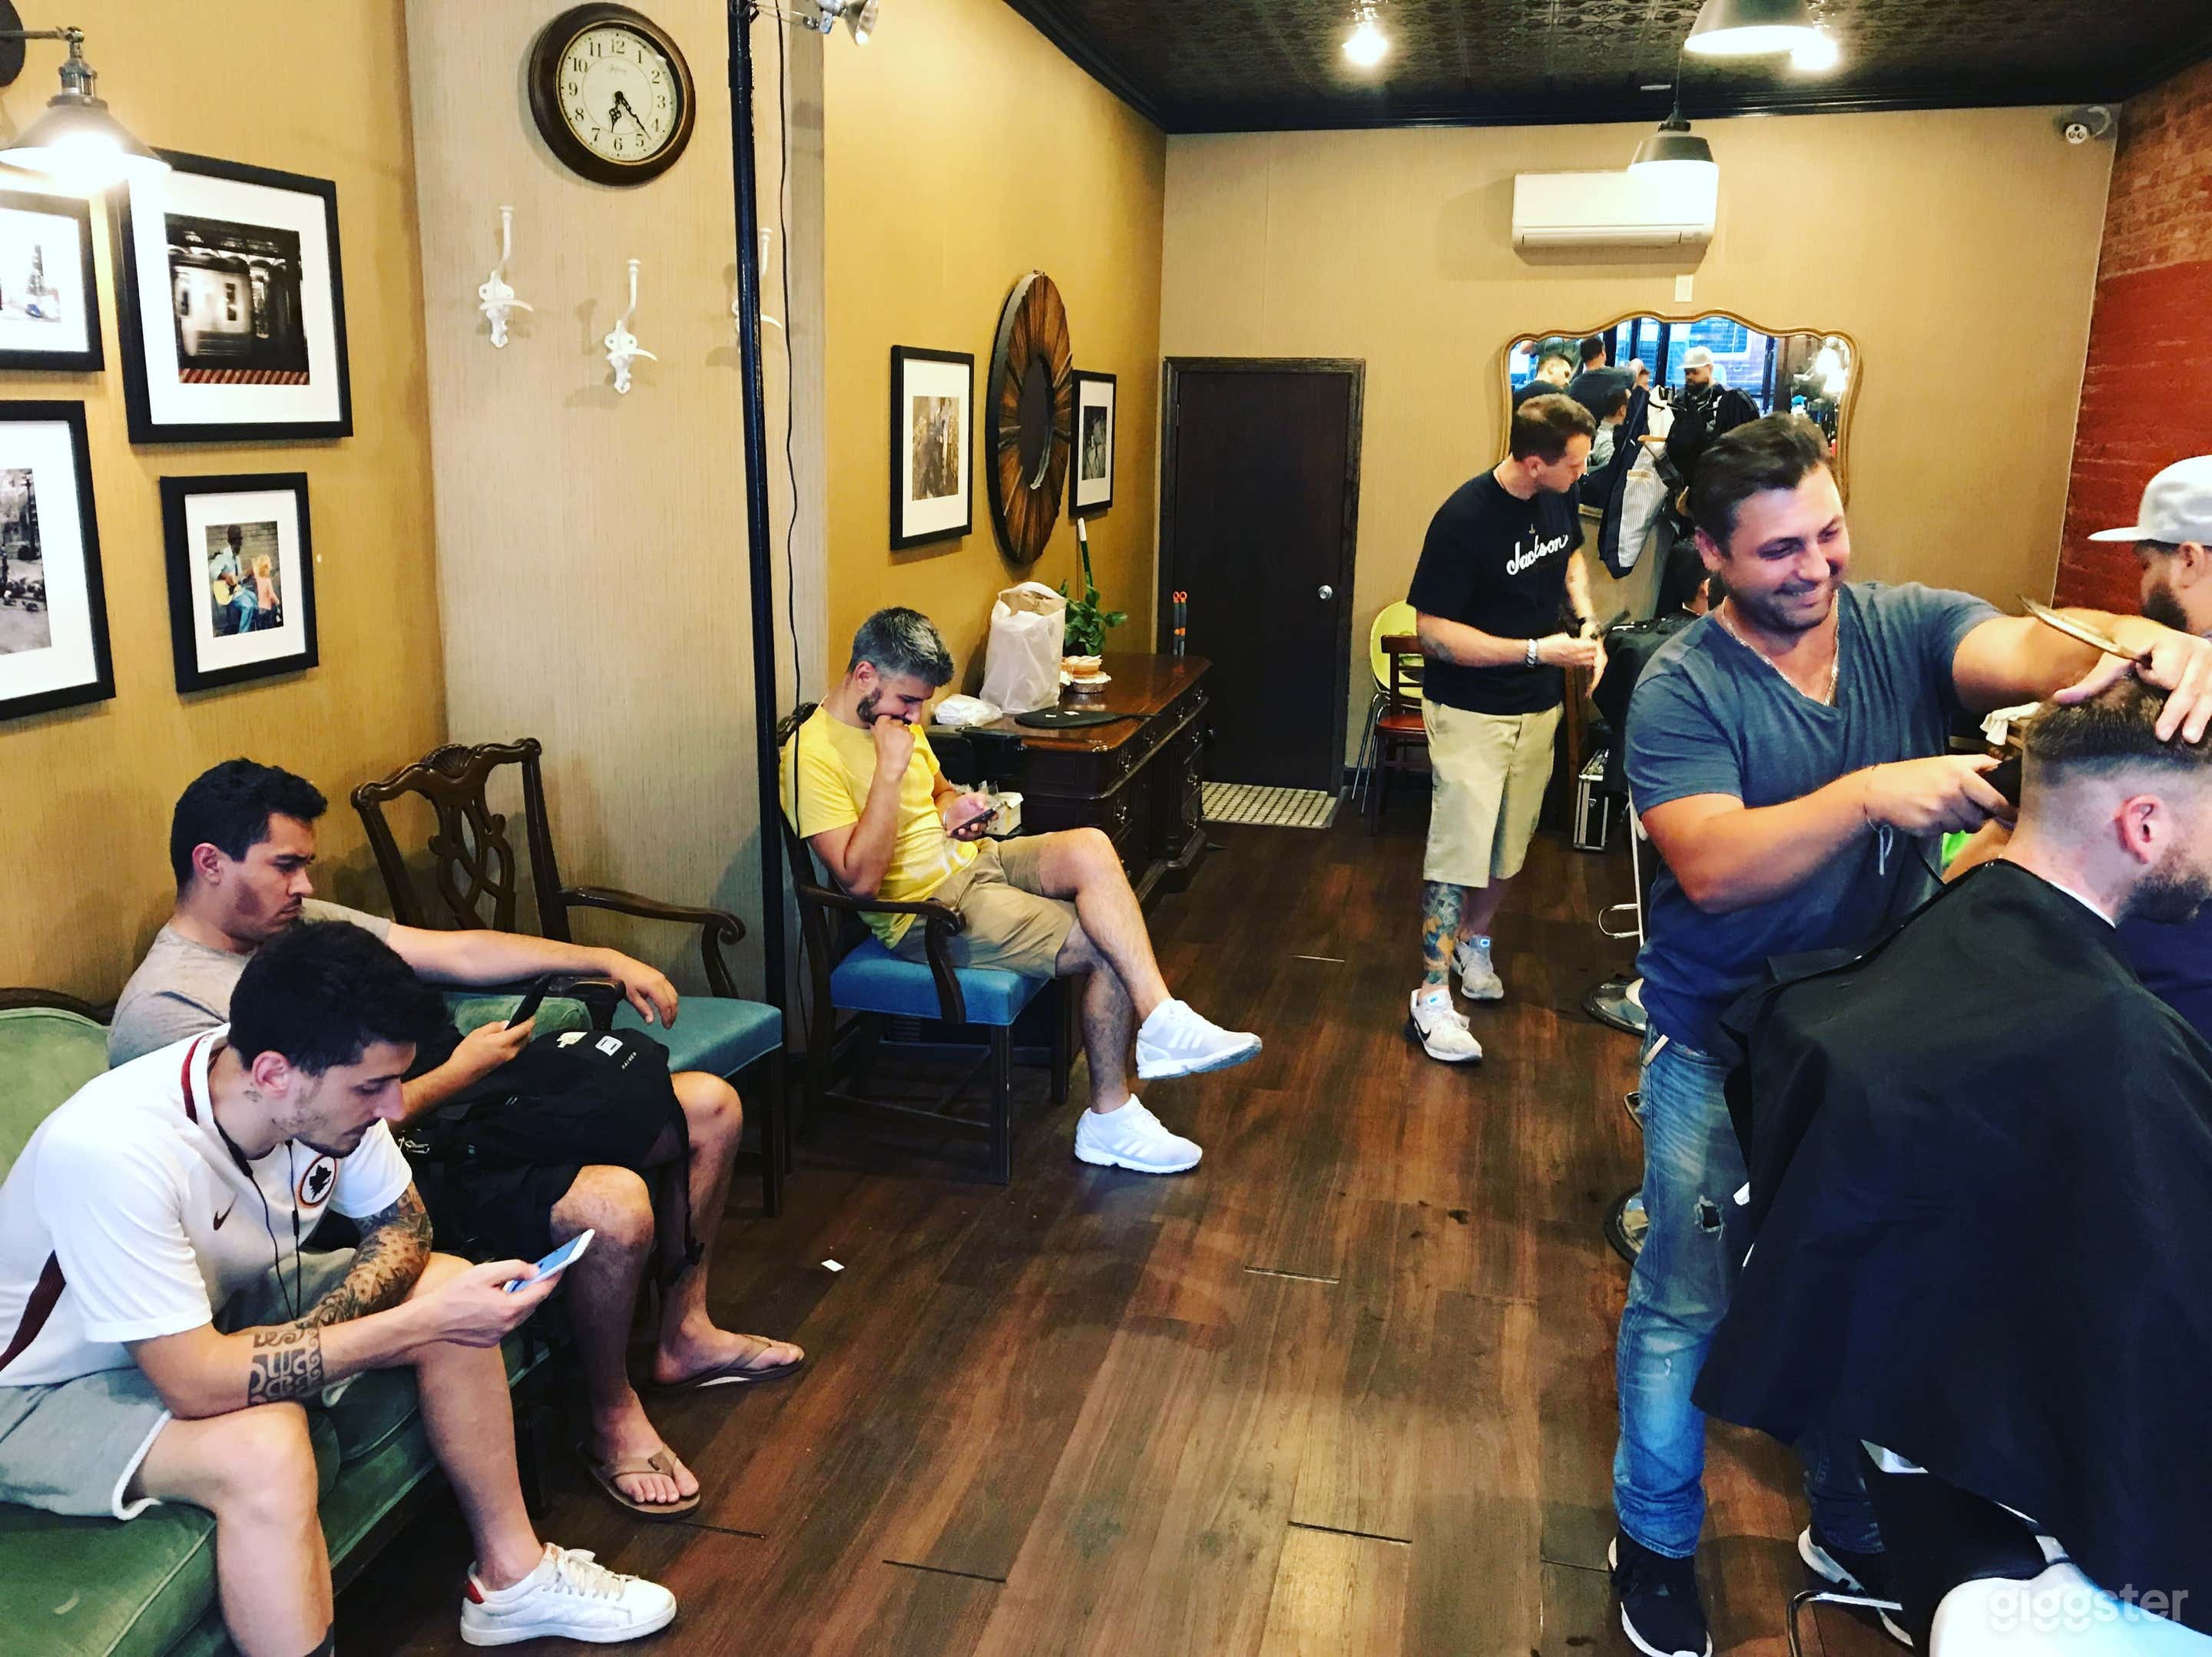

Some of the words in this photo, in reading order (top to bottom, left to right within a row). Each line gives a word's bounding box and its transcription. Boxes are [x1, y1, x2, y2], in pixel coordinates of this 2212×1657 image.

[591, 41, 601, 58] 11
[611, 39, 625, 54] 12
[638, 50, 642, 64] 1
[573, 58, 588, 72] 10
[651, 70, 660, 84] 2
[568, 82, 578, 96] 9
[657, 94, 665, 108] 3
[575, 107, 584, 121] 8
[651, 118, 659, 132] 4
[591, 127, 601, 141] 7
[636, 133, 644, 147] 5
[614, 137, 622, 150] 6
[1506, 534, 1568, 575] Jackson
